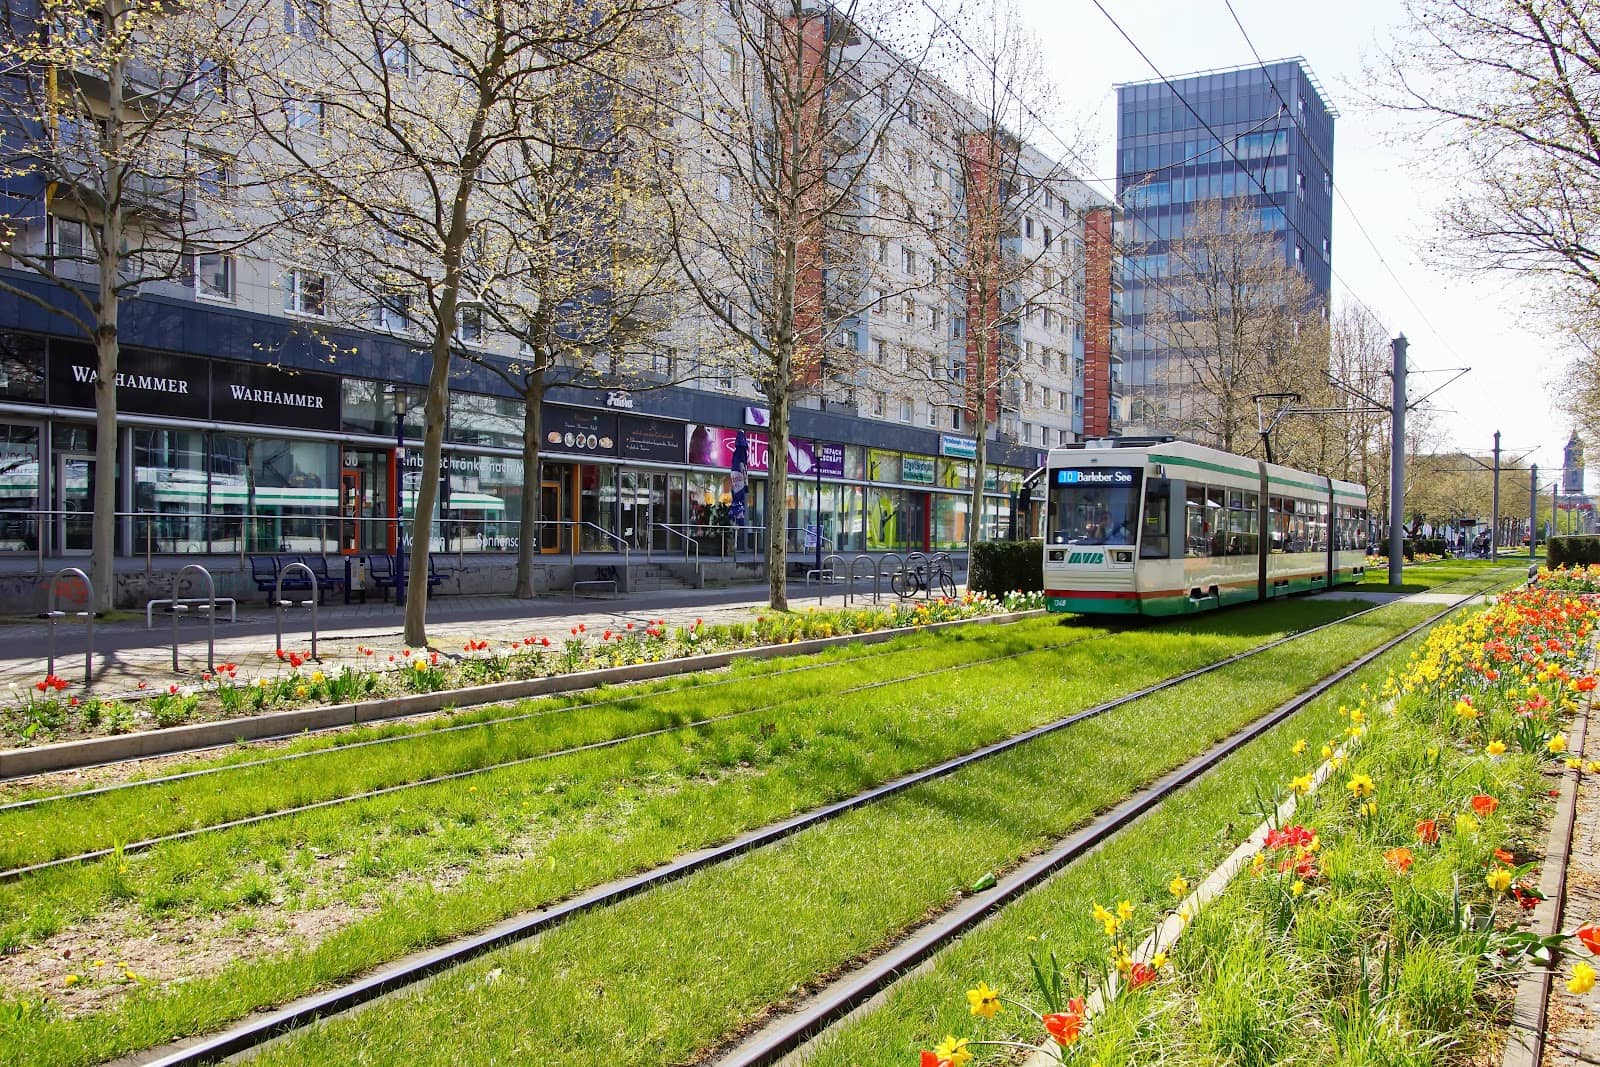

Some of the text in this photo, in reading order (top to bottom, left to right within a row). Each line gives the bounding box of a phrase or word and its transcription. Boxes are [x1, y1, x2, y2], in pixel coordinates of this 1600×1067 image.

[71, 365, 188, 394] WAHAMMER
[230, 384, 324, 409] WARHAMMER
[1077, 471, 1113, 482] Barleber
[1115, 471, 1132, 482] See
